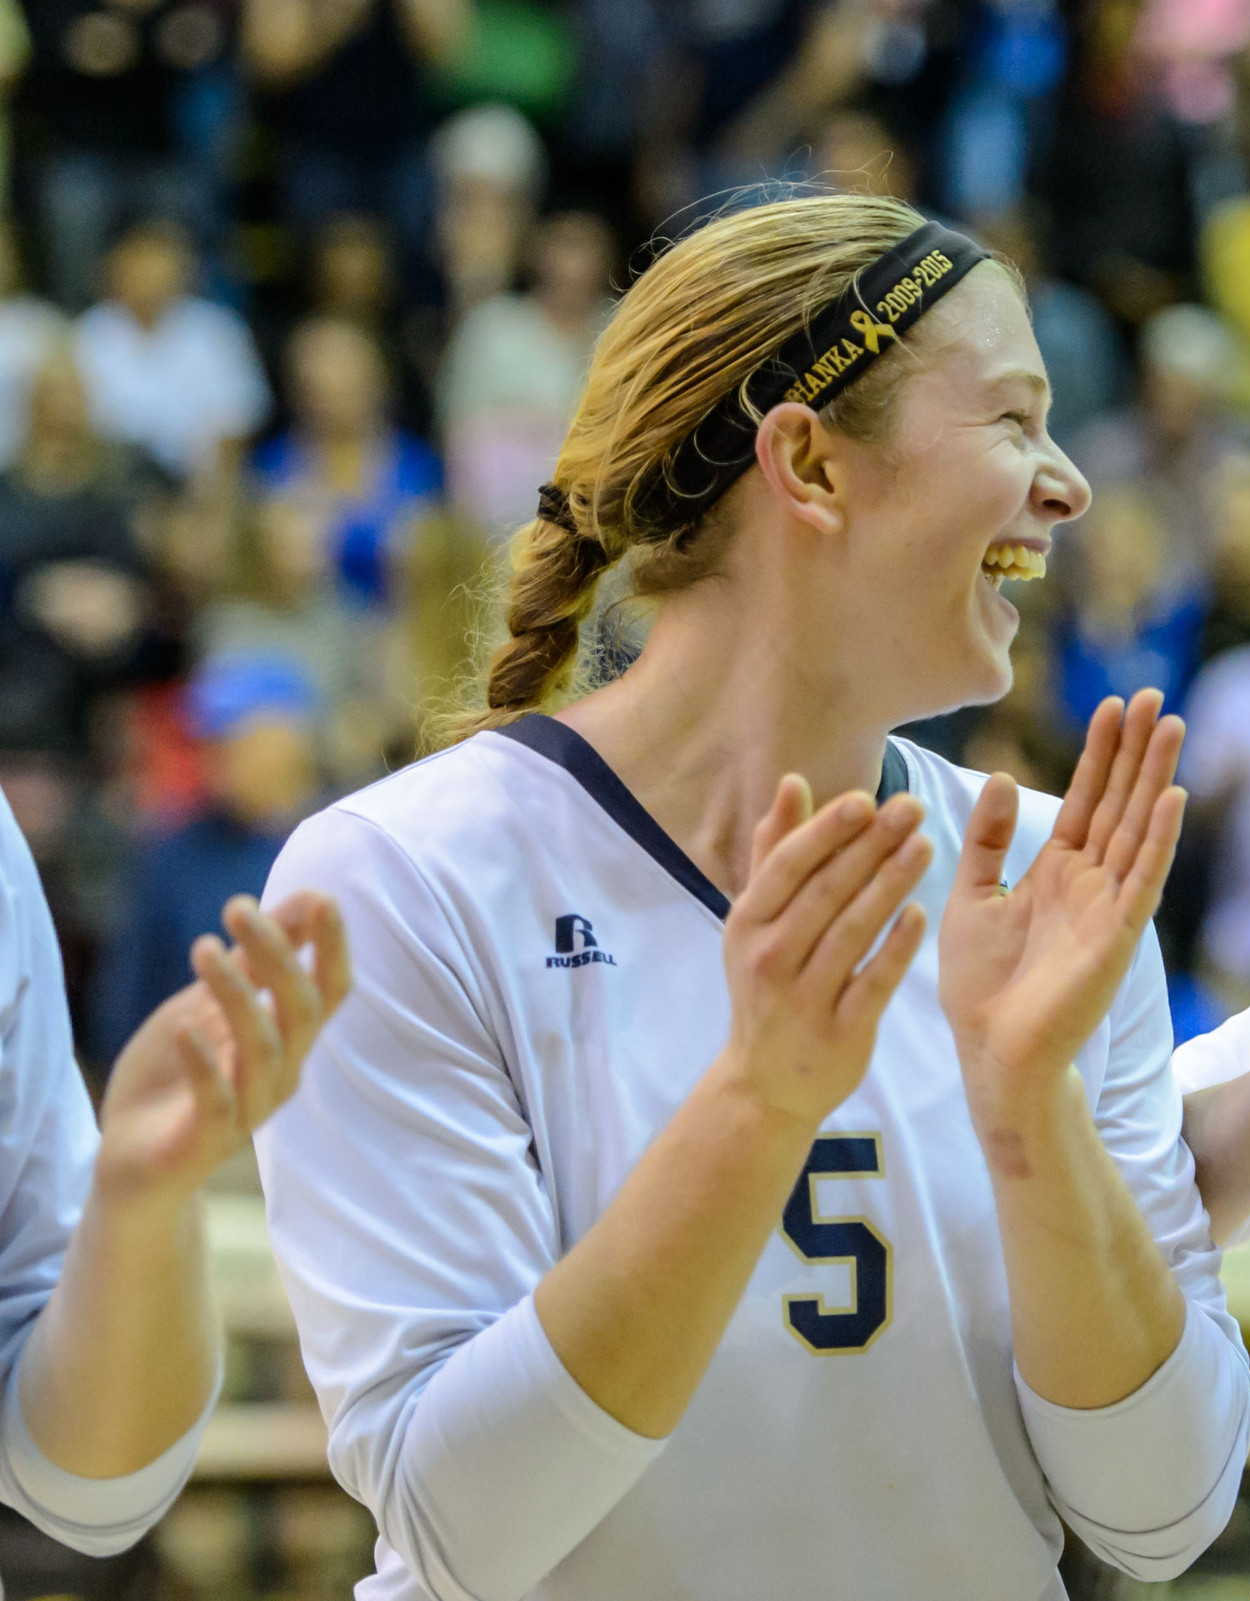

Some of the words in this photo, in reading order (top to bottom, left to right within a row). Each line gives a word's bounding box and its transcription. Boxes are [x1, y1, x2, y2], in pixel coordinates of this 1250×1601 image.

[877, 249, 954, 323] 2009-2015
[545, 950, 617, 969] RUSSELL
[777, 1131, 895, 1357] 5
